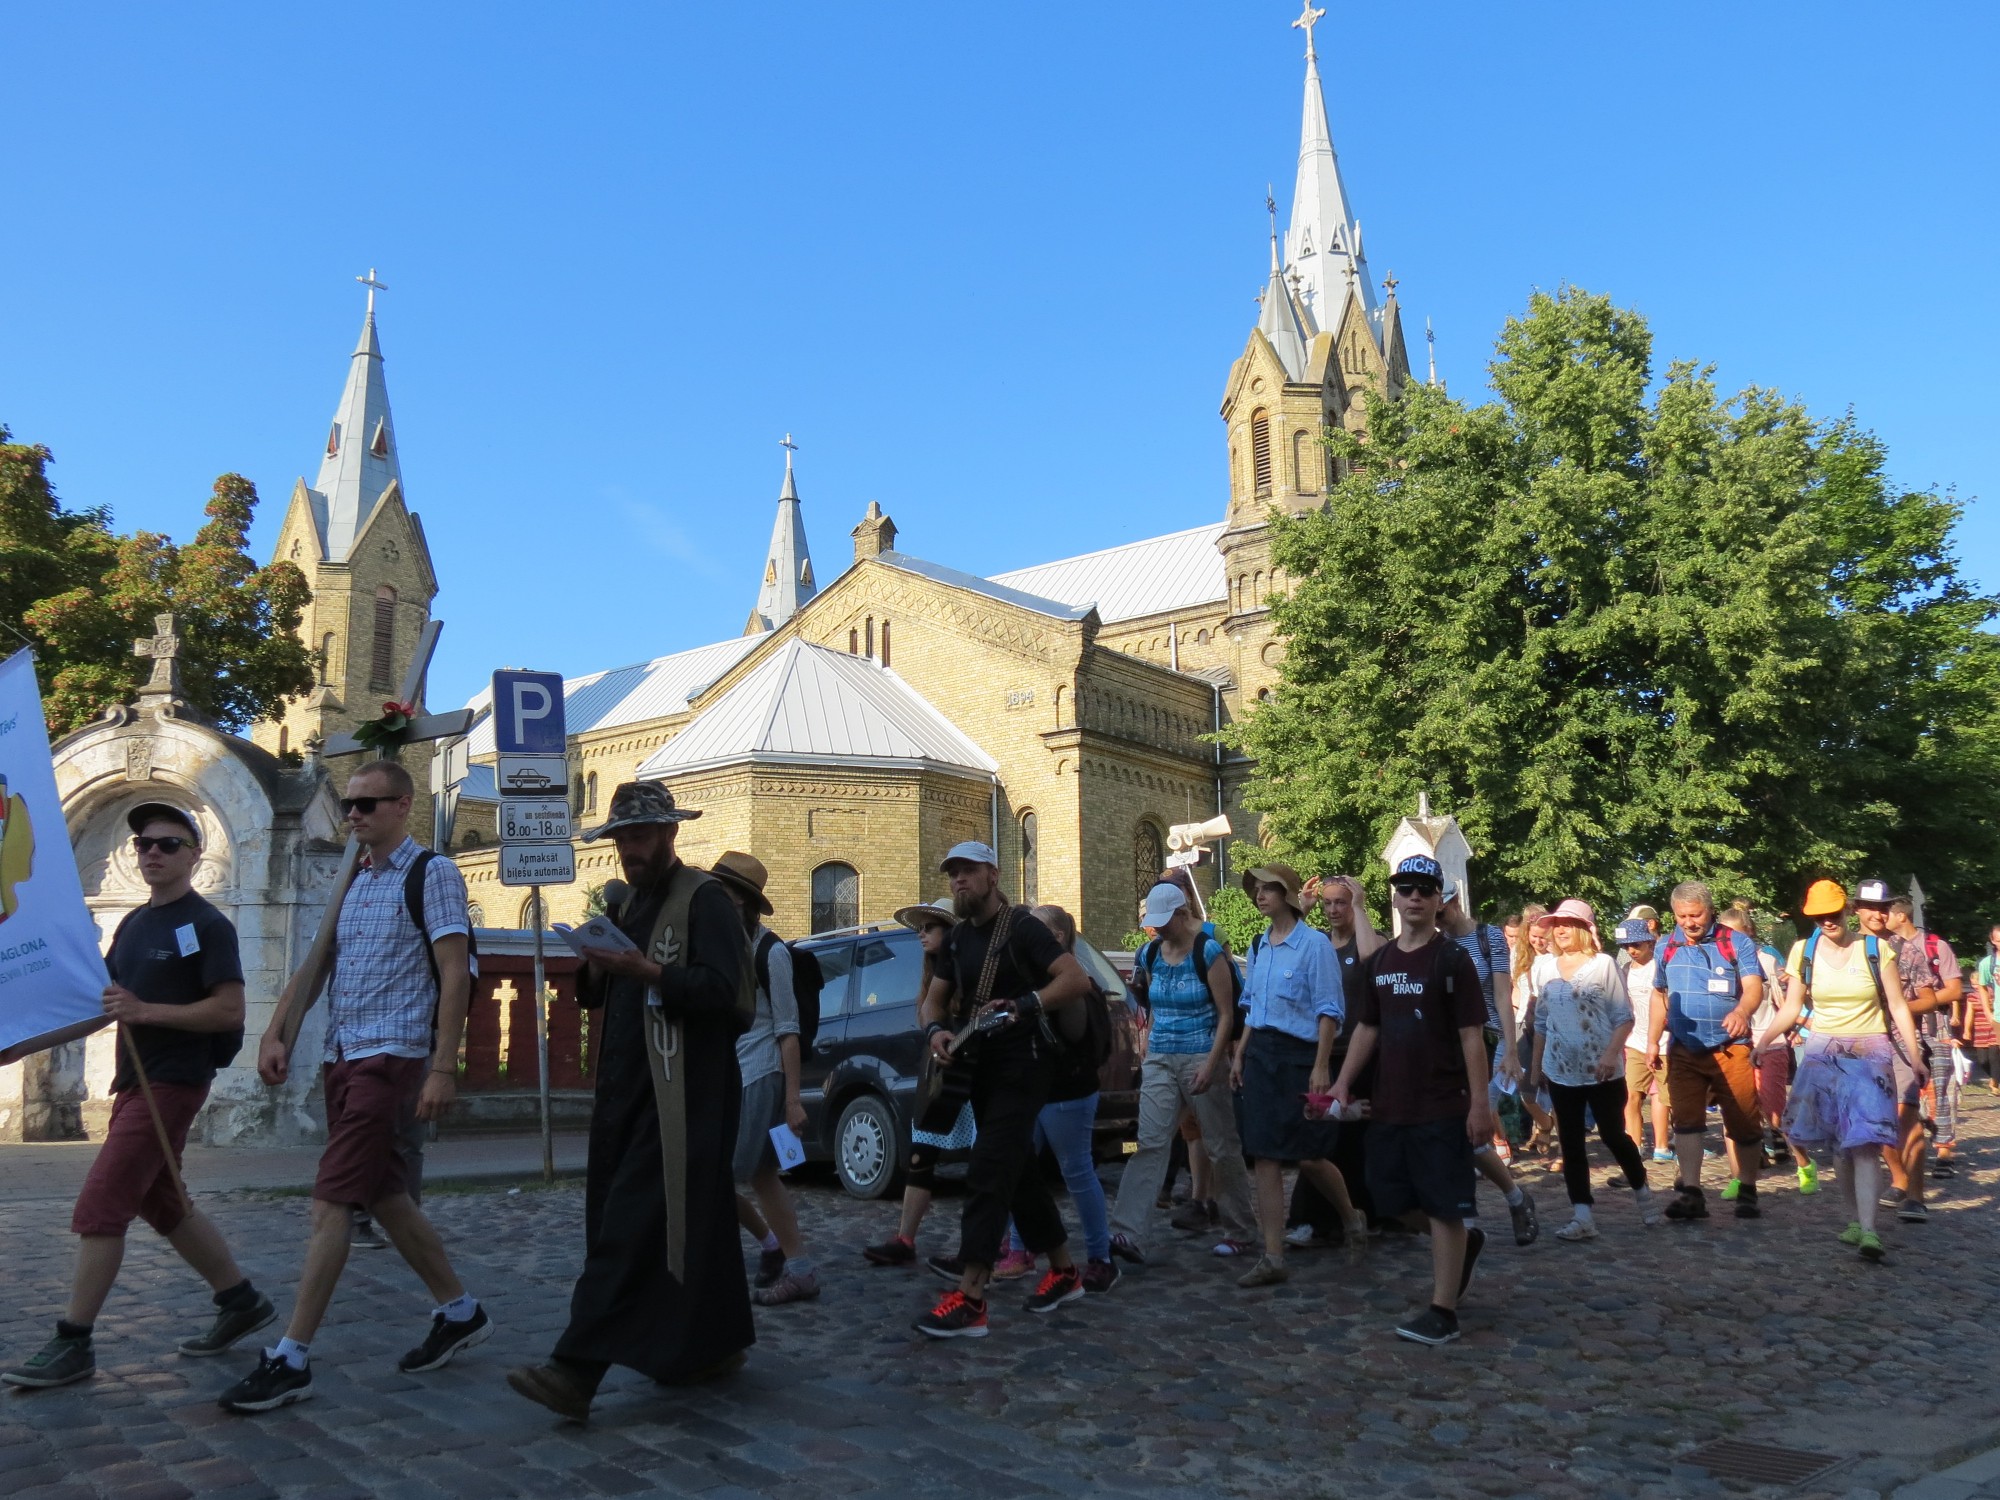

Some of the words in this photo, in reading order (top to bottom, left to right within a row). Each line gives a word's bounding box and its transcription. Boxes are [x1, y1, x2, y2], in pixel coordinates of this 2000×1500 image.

[1007, 690, 1034, 706] 1894
[512, 681, 552, 745] P
[519, 853, 558, 865] Apmaksāt
[1400, 858, 1436, 875] RICH
[507, 867, 532, 880] biļešu
[534, 866, 571, 877] automātā
[0, 938, 47, 962] AGLONA
[1375, 972, 1408, 987] PRIVATE
[1392, 983, 1424, 995] BRAND
